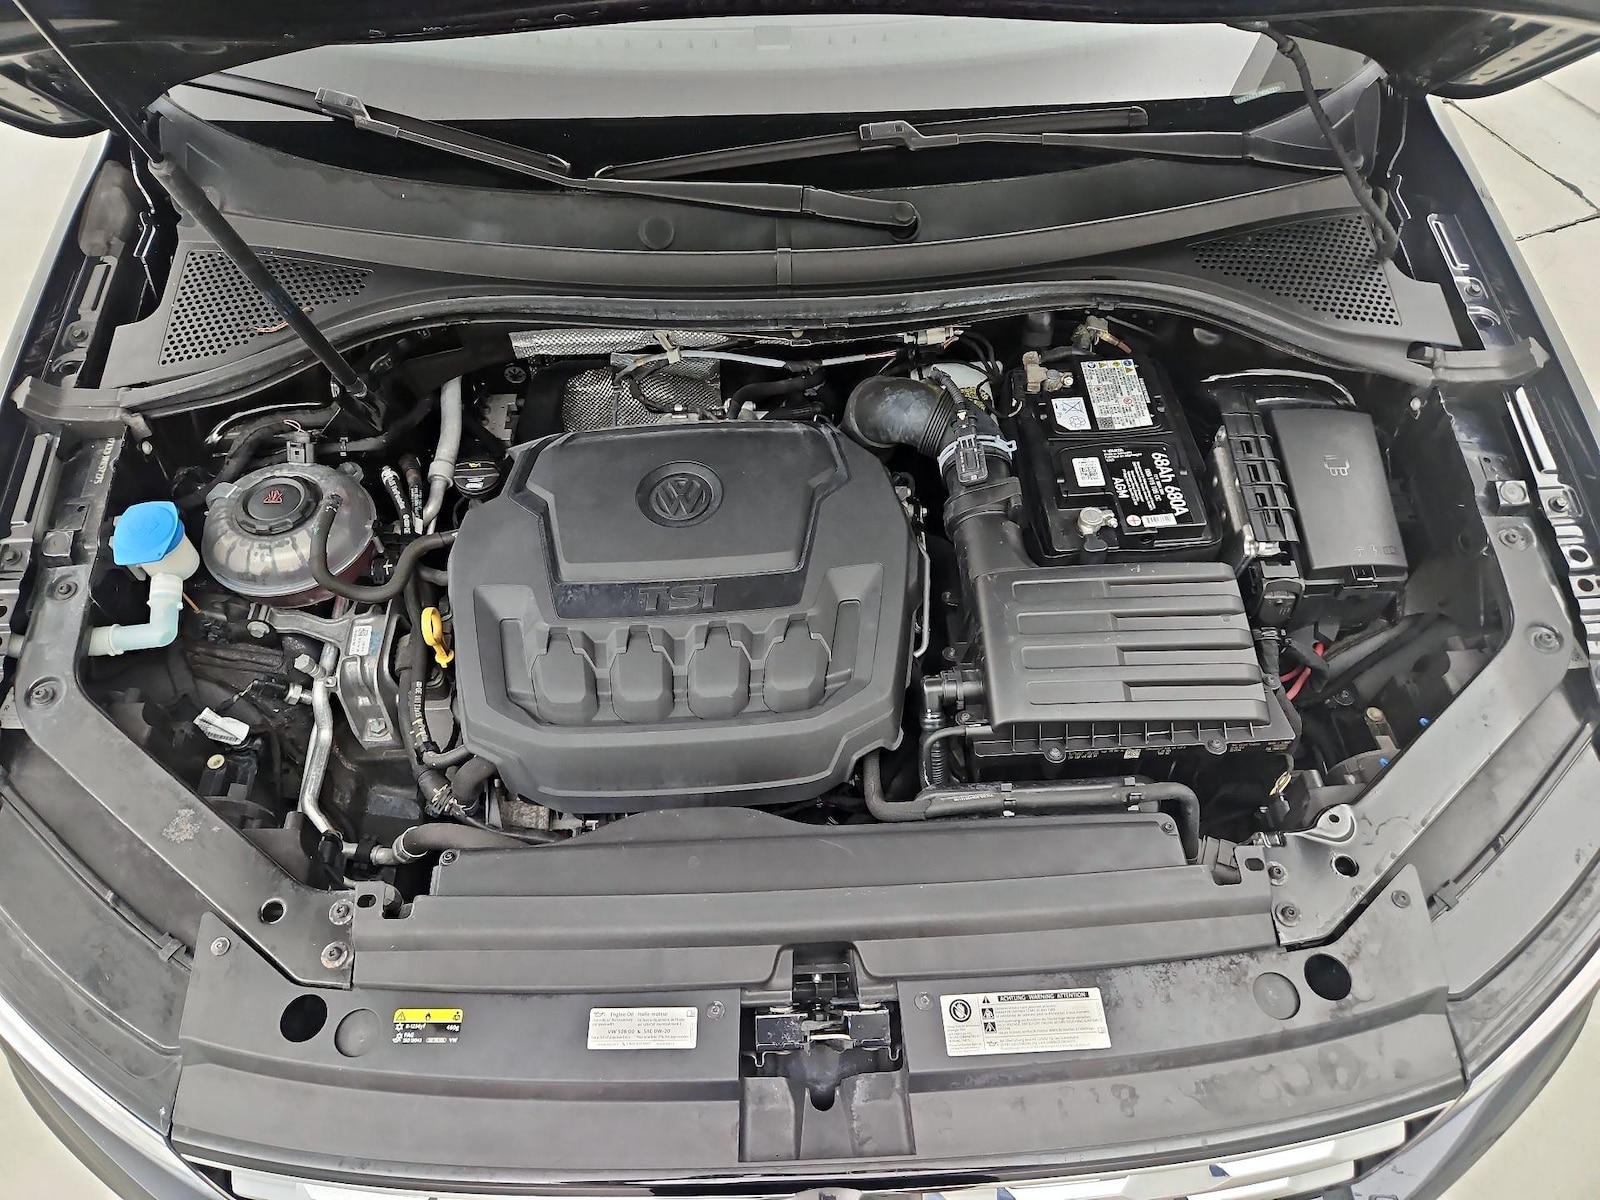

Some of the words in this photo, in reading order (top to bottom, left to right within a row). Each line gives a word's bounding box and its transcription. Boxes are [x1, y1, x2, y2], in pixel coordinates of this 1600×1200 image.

[1112, 477, 1130, 499] AGM
[1151, 452, 1176, 483] 68Ah
[1164, 485, 1190, 517] 680A
[638, 583, 718, 611] TSI
[1000, 994, 1026, 1002] ACHTUNG
[1028, 993, 1054, 1001] WARNING
